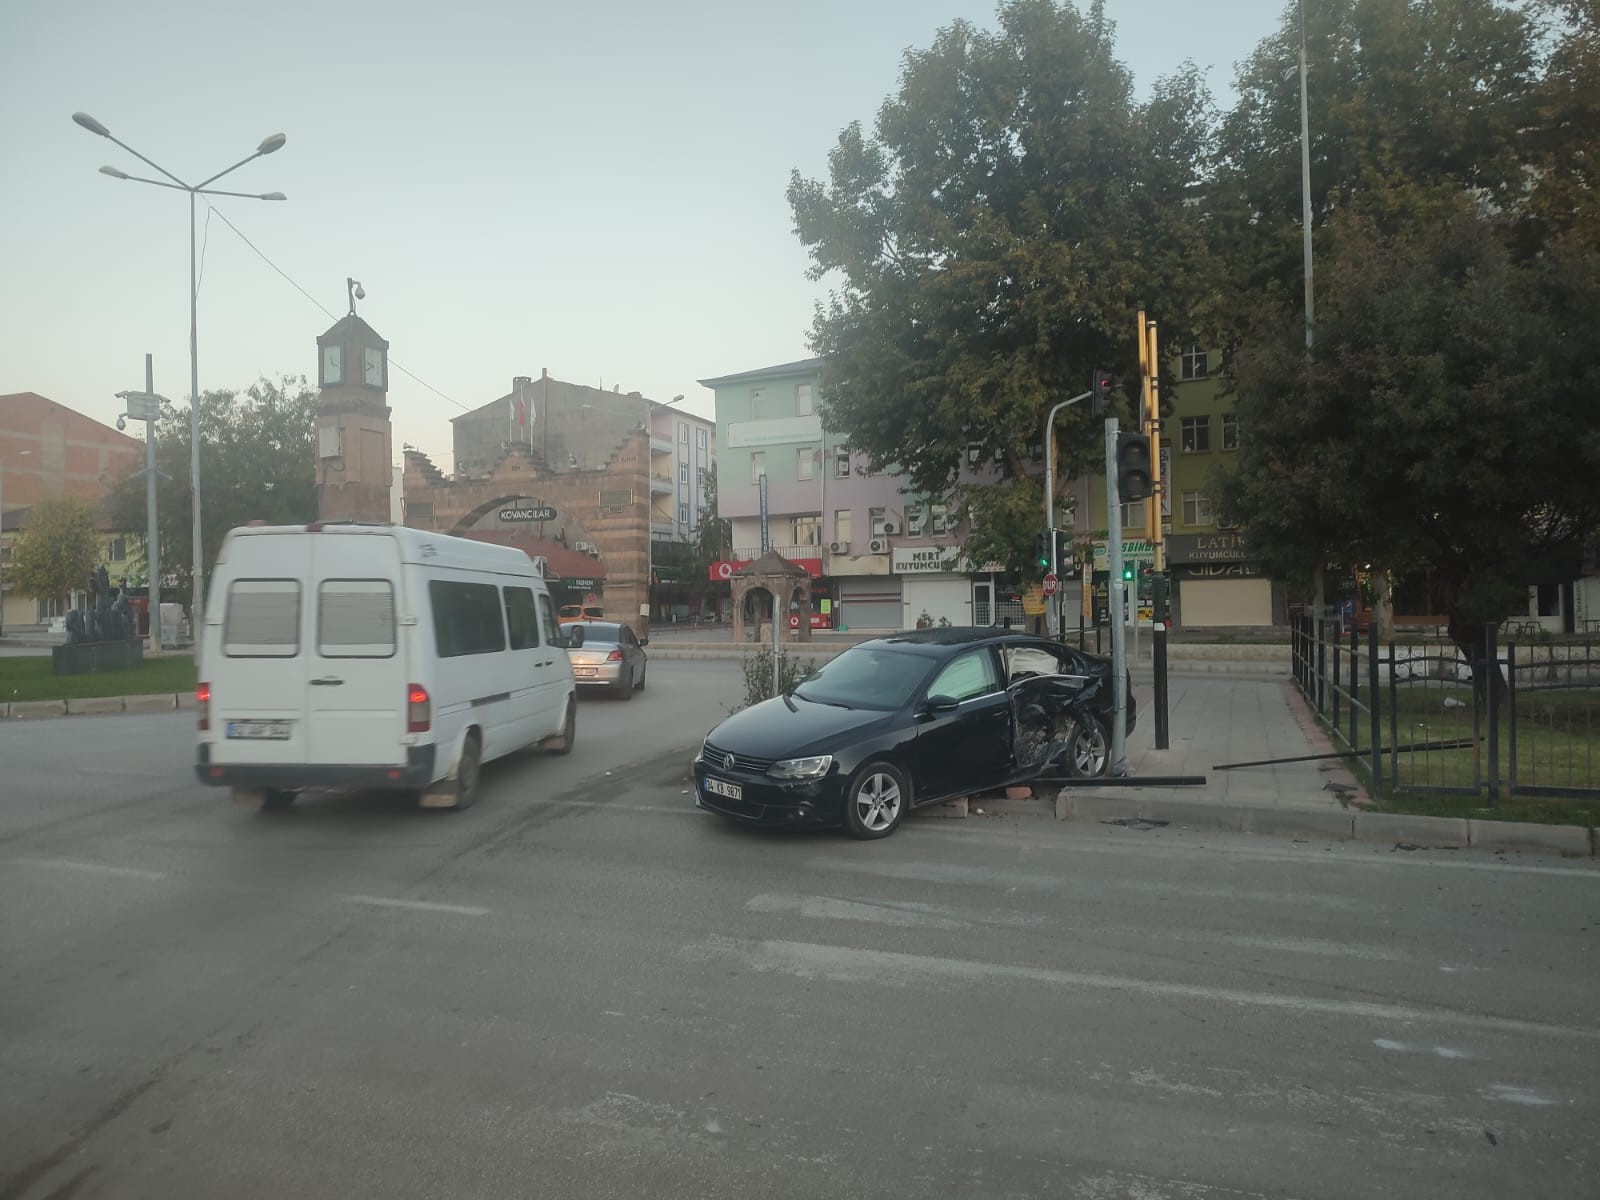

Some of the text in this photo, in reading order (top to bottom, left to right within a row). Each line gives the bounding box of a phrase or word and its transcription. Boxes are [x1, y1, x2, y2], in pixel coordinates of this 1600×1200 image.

[501, 509, 550, 519] KOVANCILAR
[912, 551, 940, 562] MERT
[1044, 580, 1056, 590] DUR
[706, 779, 714, 792] 34
